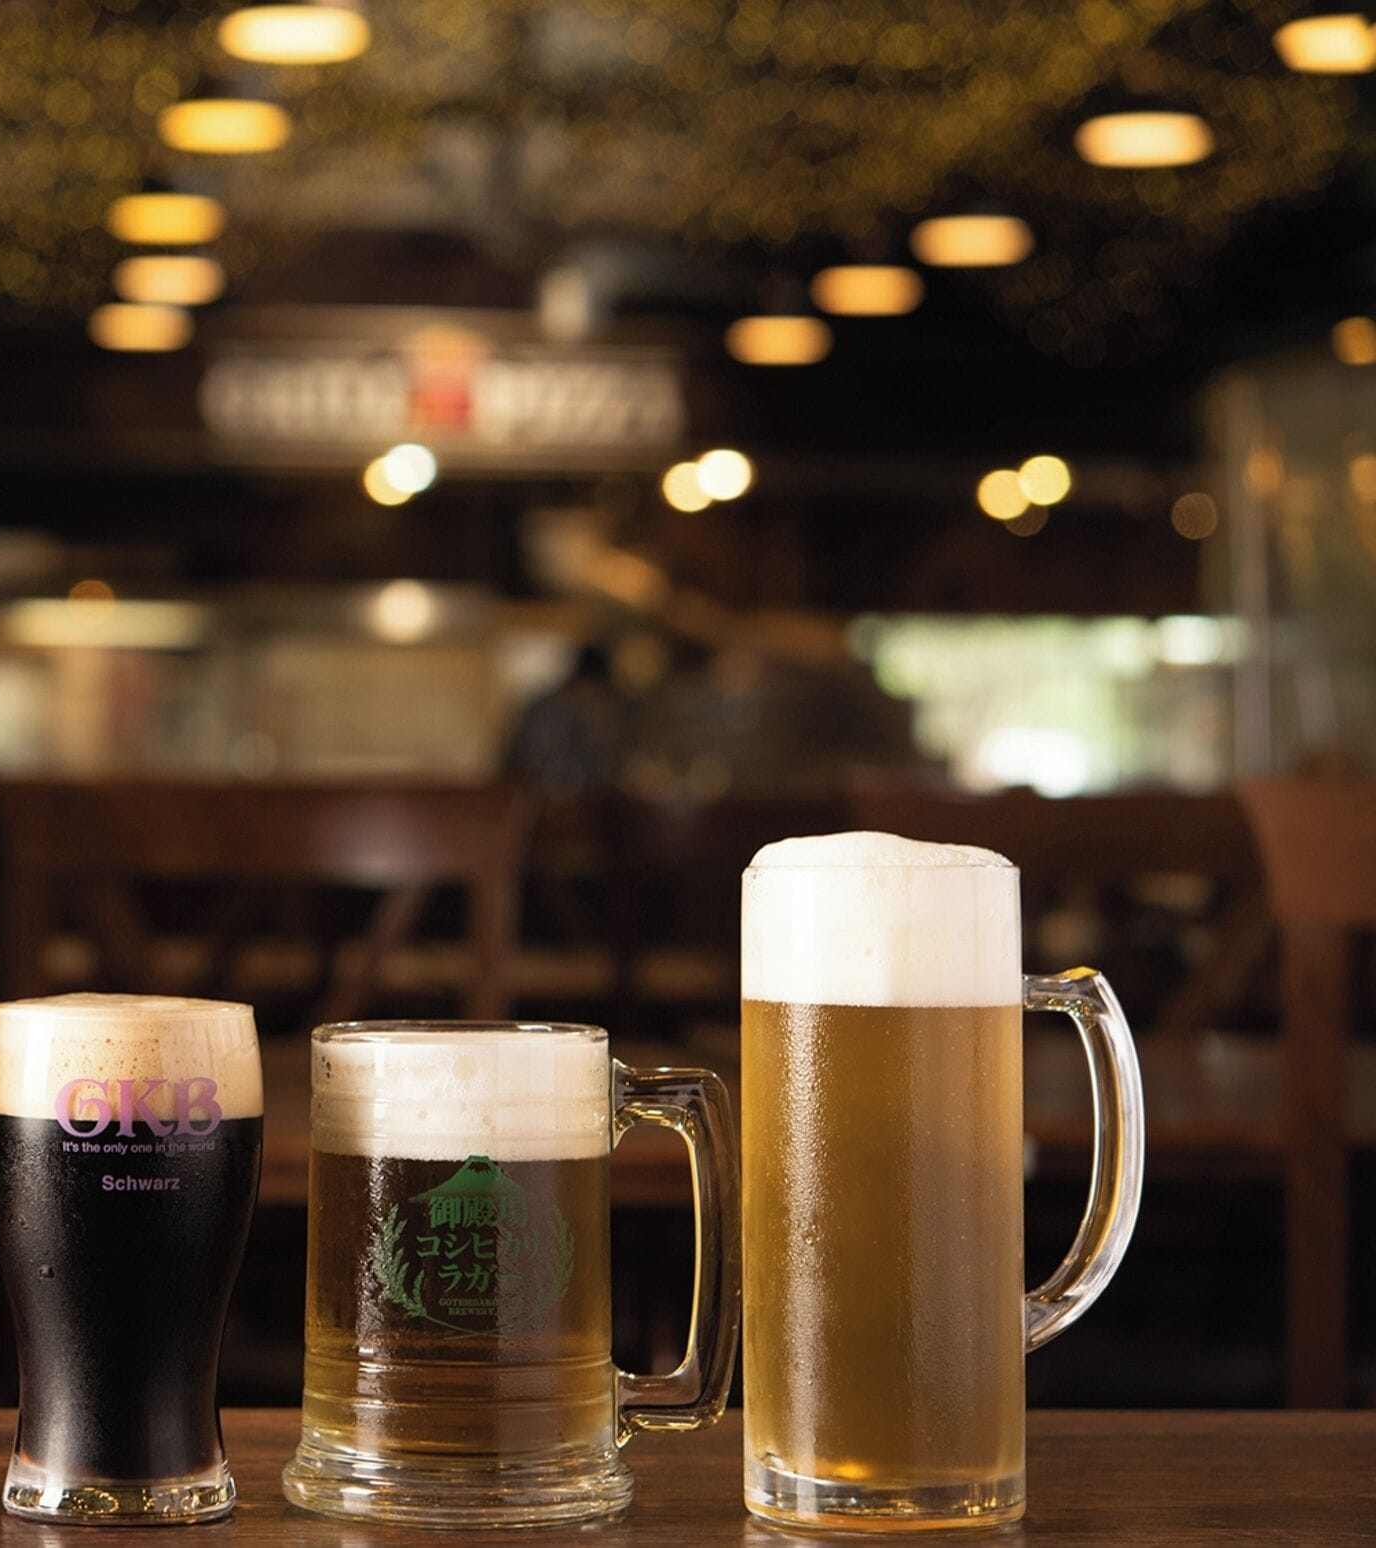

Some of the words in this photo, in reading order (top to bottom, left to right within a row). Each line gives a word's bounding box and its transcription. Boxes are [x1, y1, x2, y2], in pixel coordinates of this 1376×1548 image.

[54, 1077, 223, 1138] GKB
[62, 1141, 80, 1153] It's
[82, 1141, 101, 1153] the
[103, 1141, 128, 1156] only
[130, 1143, 152, 1153] one
[155, 1141, 165, 1153] in
[168, 1141, 186, 1153] the
[187, 1140, 216, 1153] world
[101, 1174, 181, 1192] Schwarz
[438, 1264, 524, 1294] ラガー
